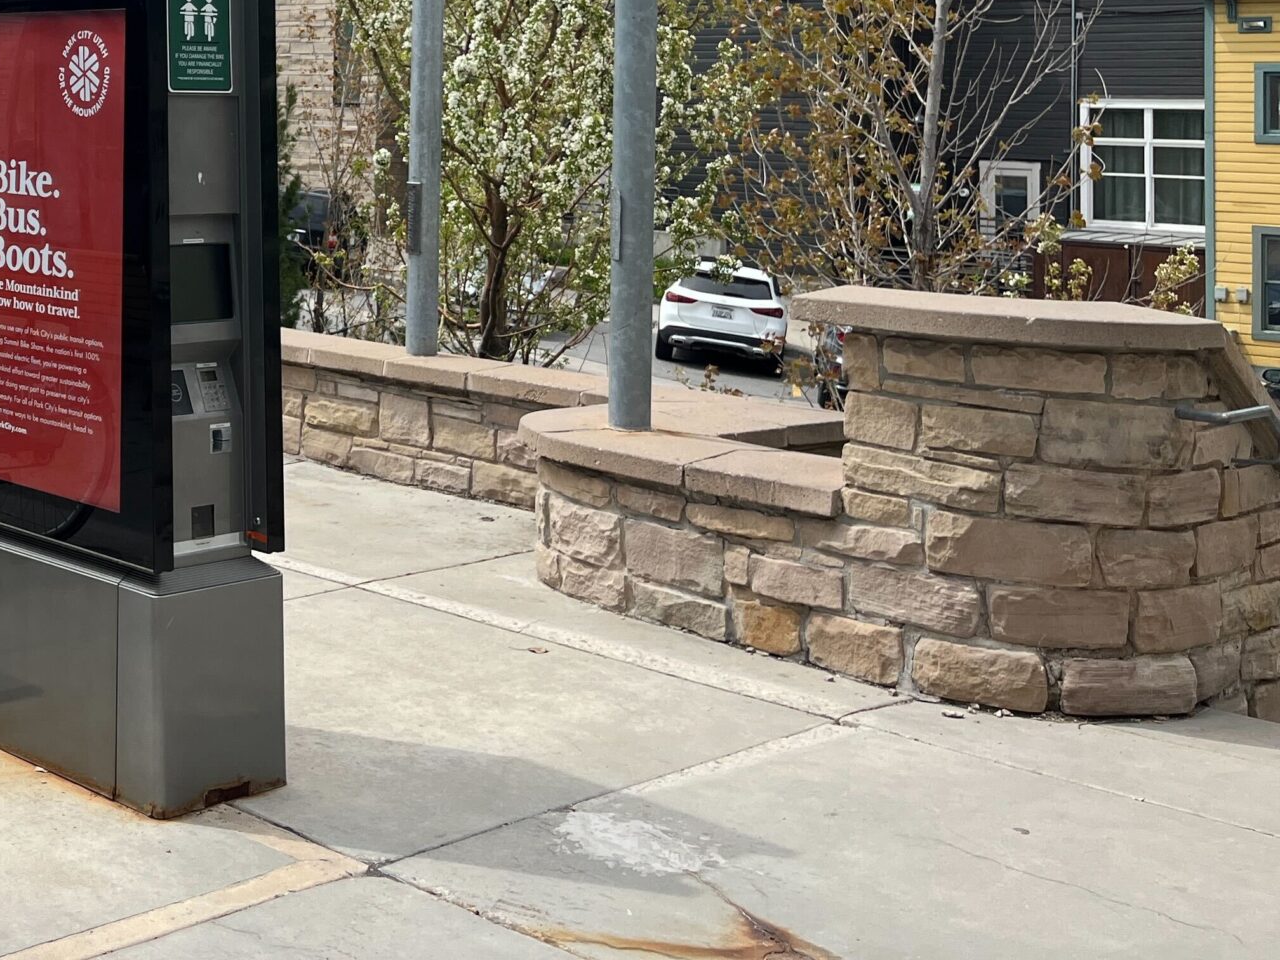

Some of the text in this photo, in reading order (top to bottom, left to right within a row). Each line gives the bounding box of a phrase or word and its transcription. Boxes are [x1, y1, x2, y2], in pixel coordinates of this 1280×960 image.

[62, 30, 109, 58] PARK CITY UTAH
[58, 66, 110, 117] FOR THE MOUNTAINKIND
[13, 296, 33, 312] how
[35, 301, 45, 314] to
[47, 303, 81, 319] travel.
[20, 339, 29, 349] Bike
[55, 346, 73, 356] nation's
[74, 349, 83, 358] first
[85, 351, 100, 361] 100%
[30, 328, 39, 336] Park
[40, 330, 53, 339] City's
[54, 332, 68, 341] public
[69, 335, 84, 343] transit
[85, 338, 104, 348] options,
[14, 352, 29, 362] electric
[43, 359, 57, 368] you're
[58, 362, 82, 374] powering
[12, 365, 24, 376] effort
[24, 368, 40, 379] toward
[41, 374, 58, 383] greater
[59, 377, 91, 390] sustainability.
[5, 379, 18, 390] doing
[18, 384, 29, 392] your
[30, 385, 39, 394] part
[40, 387, 45, 395] to
[46, 390, 66, 400] preserve
[68, 393, 76, 401] our
[77, 394, 90, 404] city's
[3, 408, 14, 416] more
[15, 411, 26, 420] ways
[32, 413, 39, 422] be
[73, 422, 87, 433] head
[13, 395, 21, 404] For
[28, 398, 34, 406] of
[34, 399, 43, 409] Park
[44, 401, 57, 412] City's
[58, 404, 68, 414] free
[68, 407, 83, 418] transit
[84, 411, 102, 422] options
